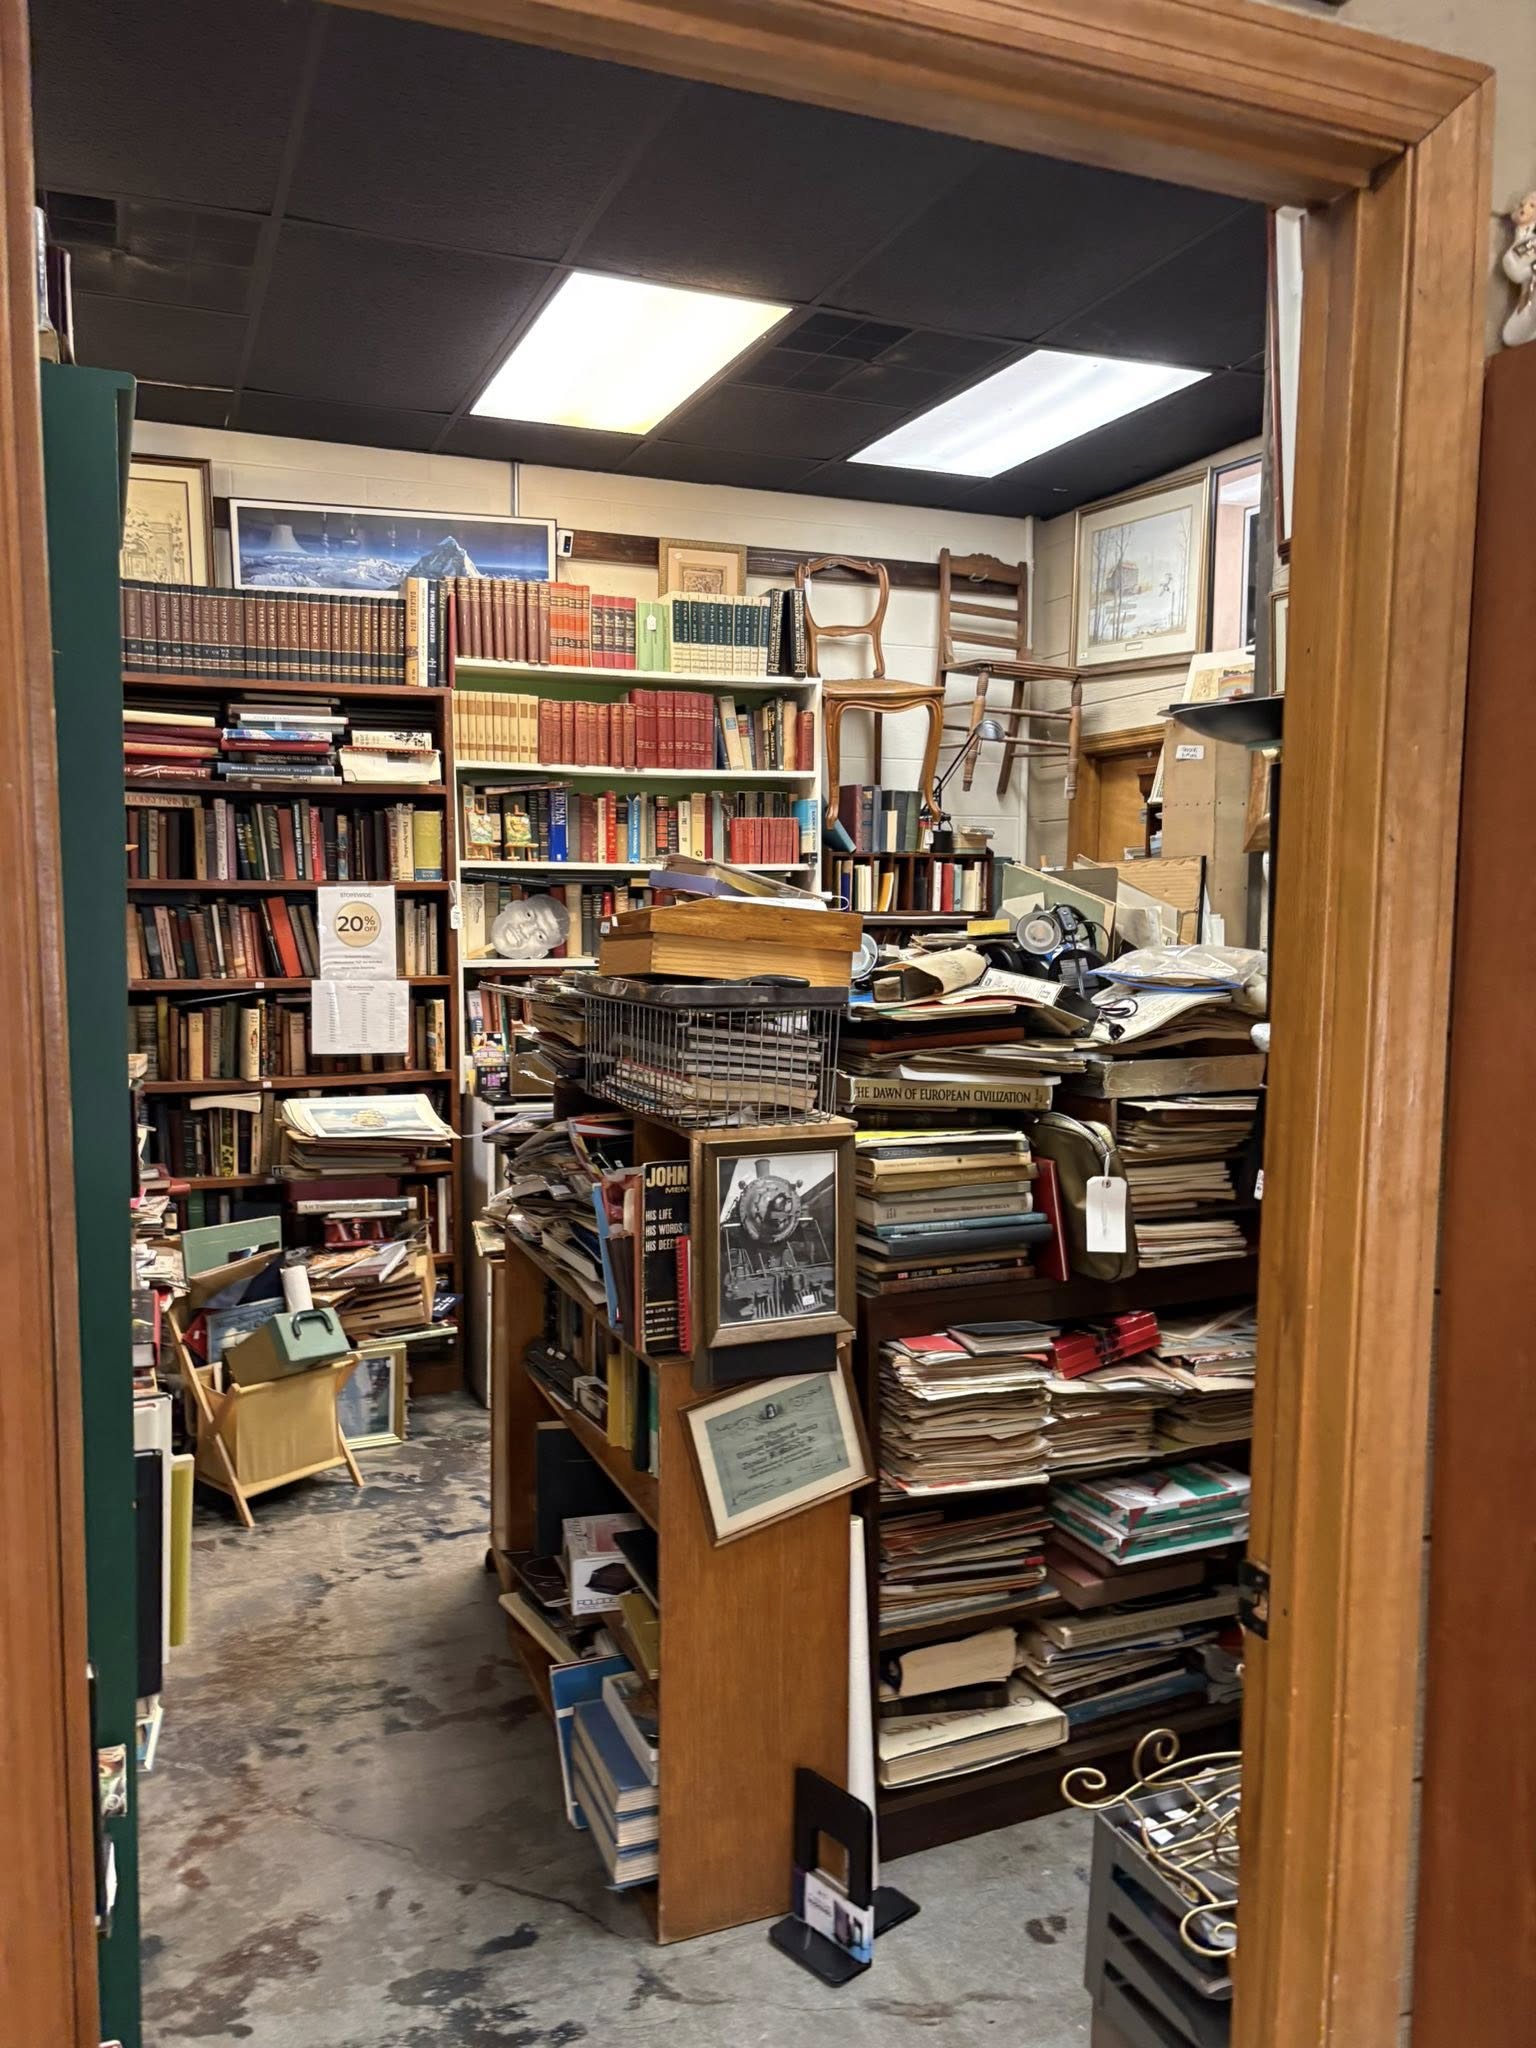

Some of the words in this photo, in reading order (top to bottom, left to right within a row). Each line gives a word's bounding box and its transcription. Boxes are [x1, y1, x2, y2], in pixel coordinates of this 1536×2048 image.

[555, 792, 566, 825] TRUMAN
[873, 1087, 902, 1099] DAWN
[905, 1088, 918, 1100] OF
[920, 1088, 970, 1102] EUROPEAN
[974, 1090, 1031, 1103] CIVILIZATION
[646, 1166, 688, 1187] JOHN
[646, 1210, 657, 1221] HIS
[659, 1208, 672, 1220] LIFE
[646, 1225, 656, 1236] HIS
[659, 1223, 683, 1234] WORDS
[646, 1241, 656, 1252] HIS
[659, 1239, 675, 1250] DEED
